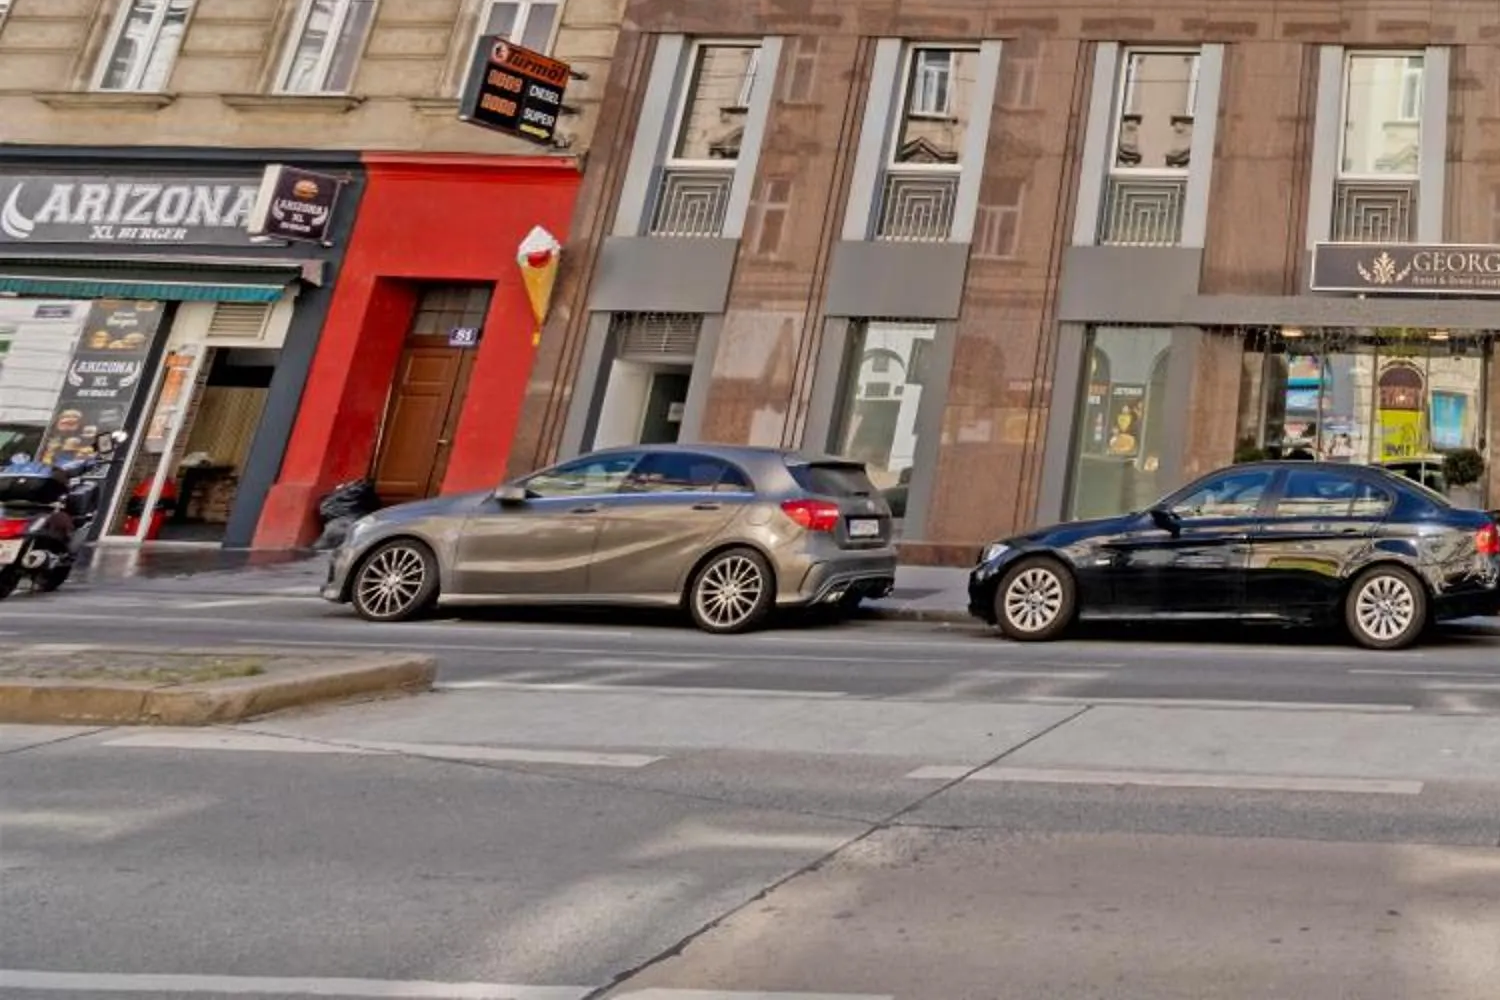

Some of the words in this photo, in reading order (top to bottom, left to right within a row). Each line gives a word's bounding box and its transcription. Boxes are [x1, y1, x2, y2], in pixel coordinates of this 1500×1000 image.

[507, 45, 568, 82] Turmöl
[529, 84, 559, 105] DIESEL
[522, 107, 555, 127] SUPER
[35, 182, 259, 227] ARIZONA
[279, 199, 323, 215] ARIZONA
[292, 213, 304, 223] XL
[89, 225, 114, 240] XL
[117, 226, 188, 241] BURGER
[76, 361, 135, 373] ARIZONA
[92, 376, 109, 387] XL
